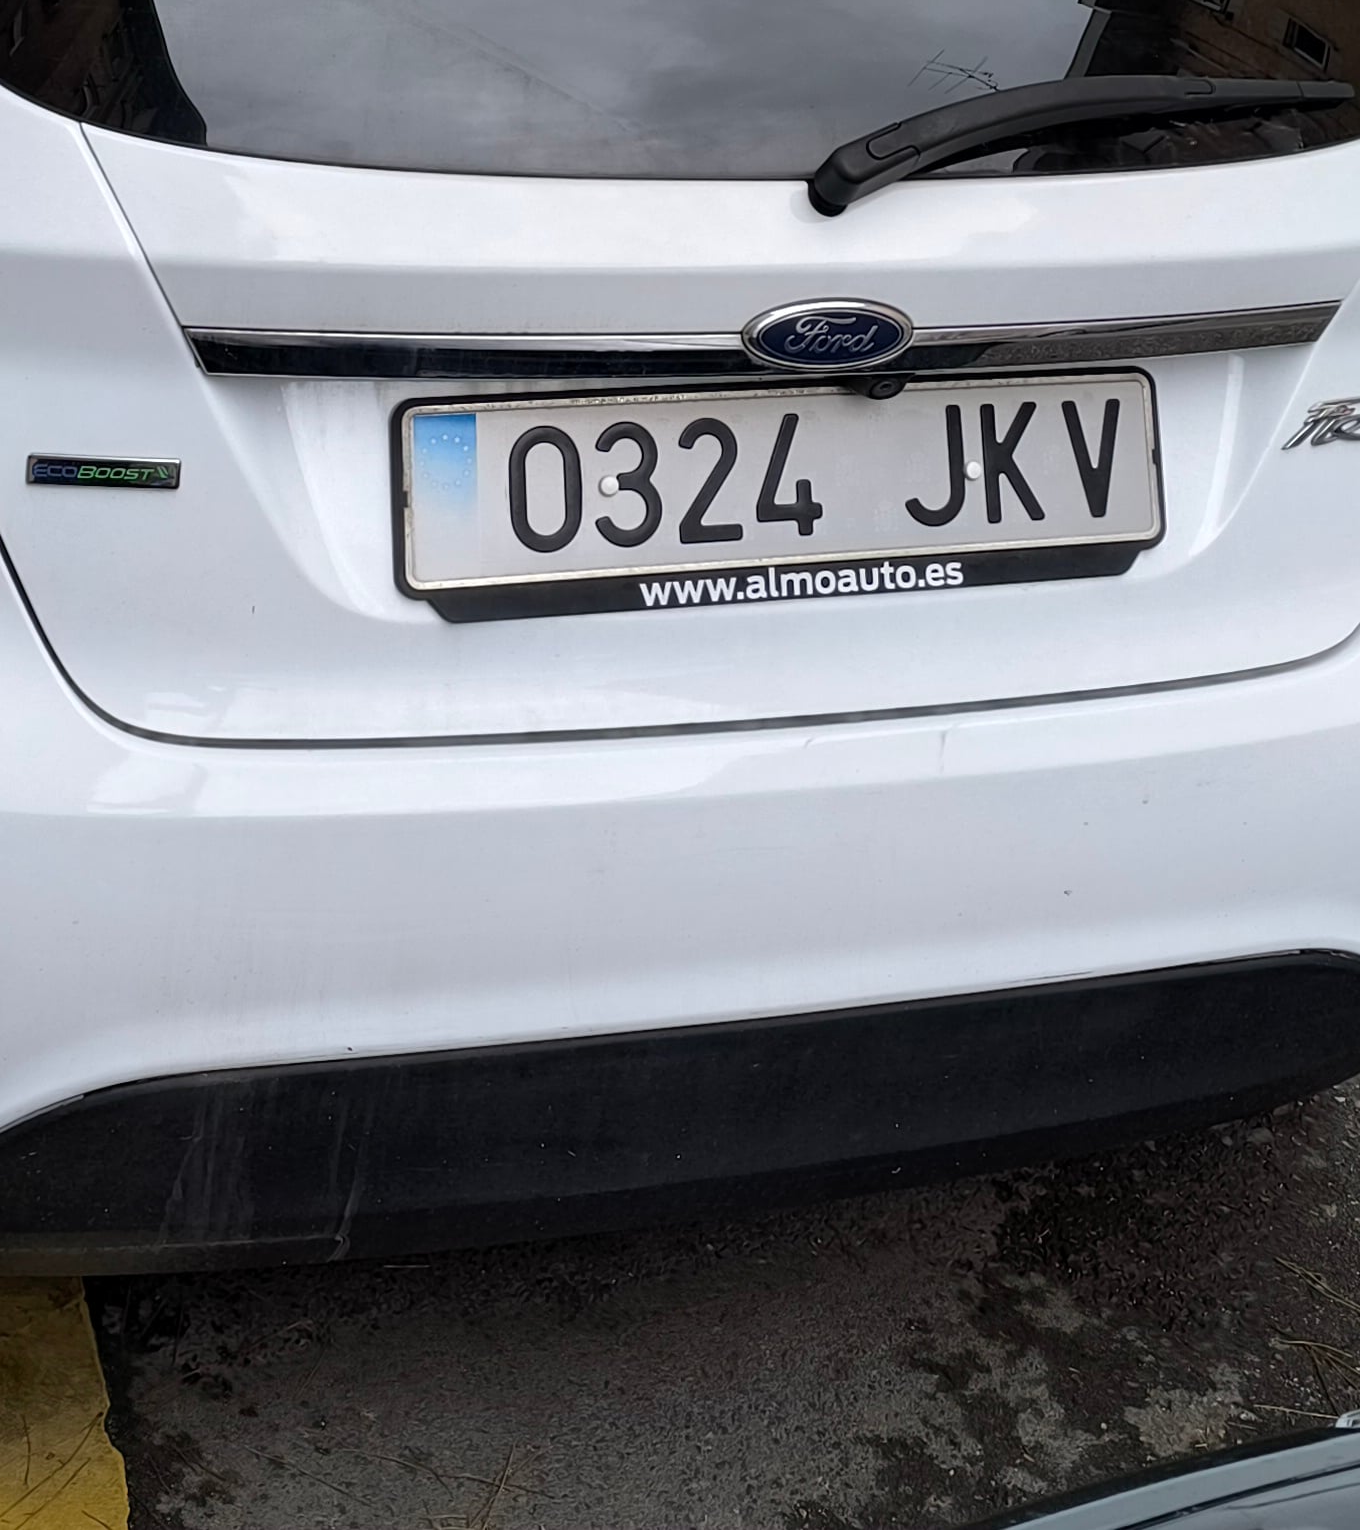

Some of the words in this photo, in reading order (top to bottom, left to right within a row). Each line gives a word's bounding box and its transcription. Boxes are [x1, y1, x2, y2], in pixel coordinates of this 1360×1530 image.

[784, 316, 880, 354] Ford
[506, 412, 825, 554] 0324
[904, 398, 1122, 528] JKV
[639, 561, 965, 607] www.almoauto.es
